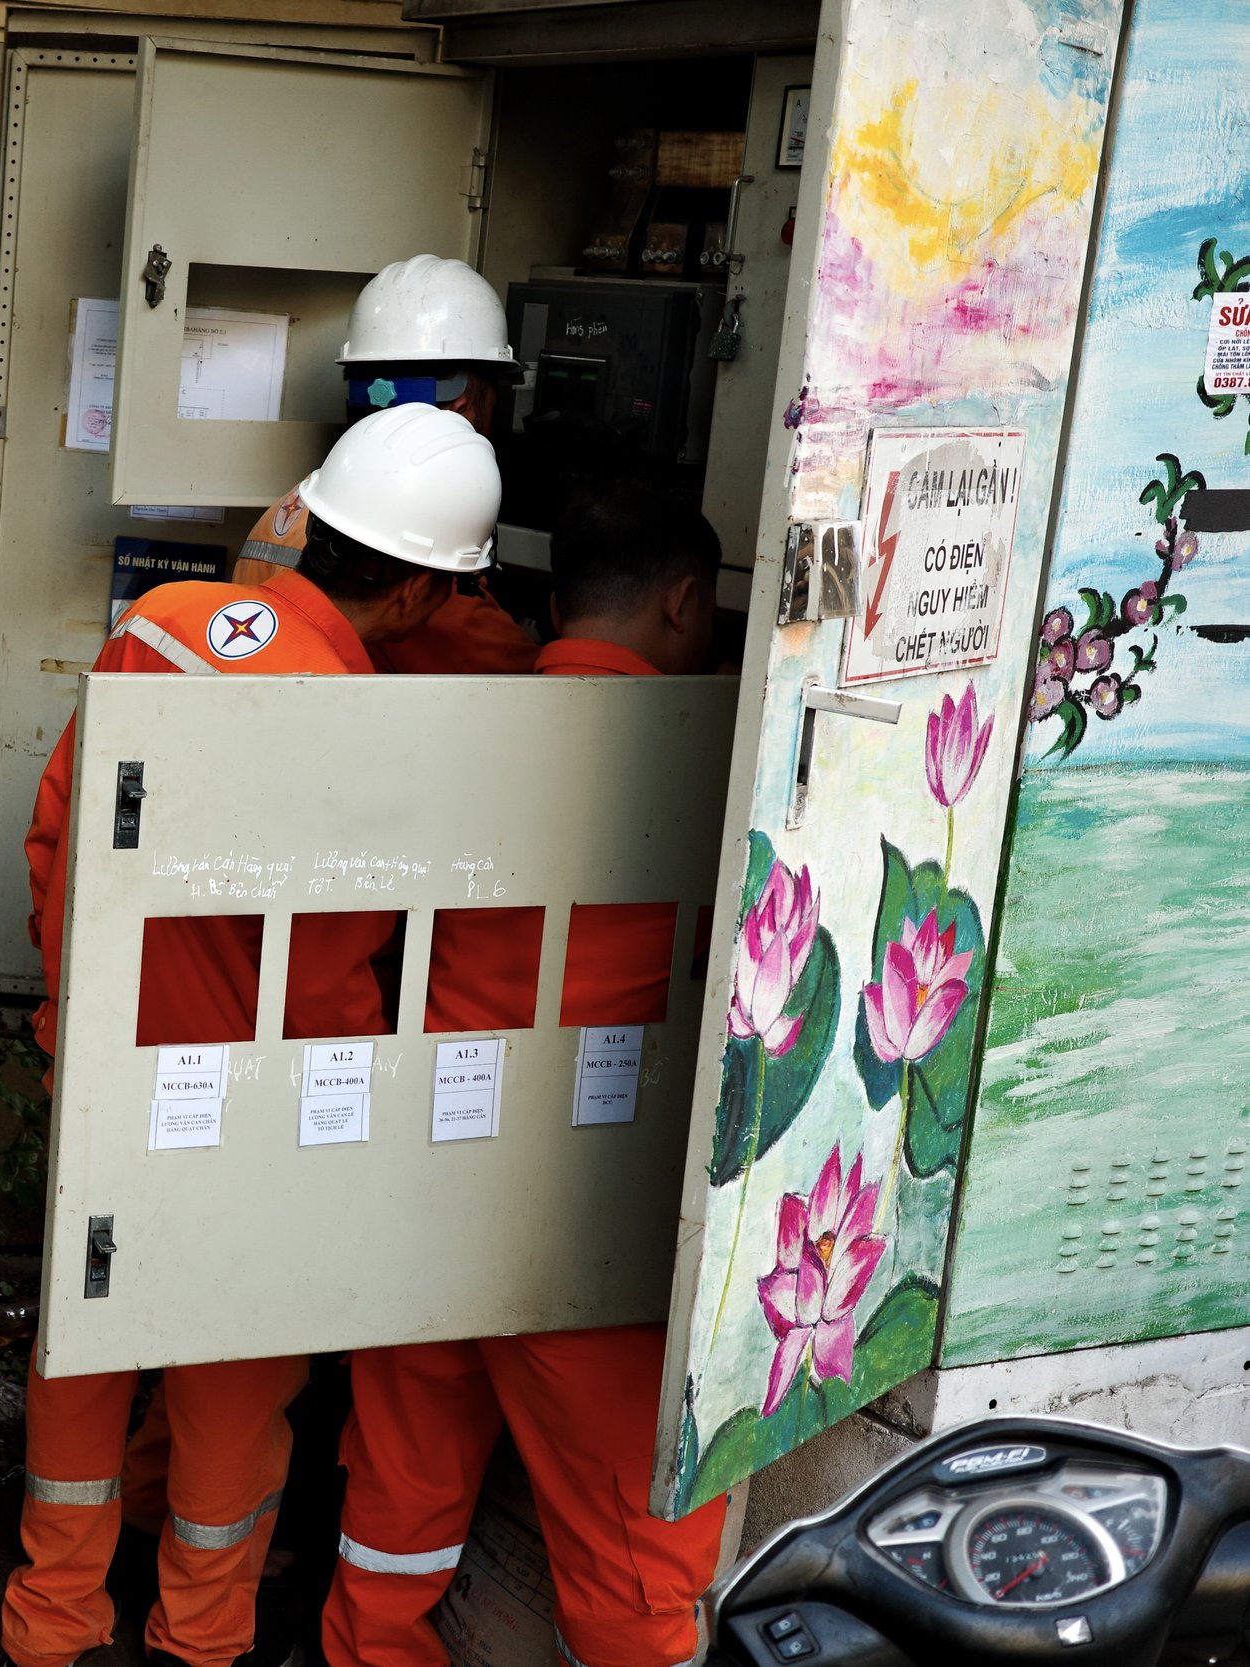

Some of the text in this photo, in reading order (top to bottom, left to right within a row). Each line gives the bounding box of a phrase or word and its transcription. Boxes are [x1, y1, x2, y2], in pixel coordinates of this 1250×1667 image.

[908, 461, 945, 511] CẤM
[947, 469, 973, 516] LẠI
[976, 459, 1009, 506] GẦN
[925, 539, 985, 575] CÓ ĐIỆN
[118, 553, 216, 574] SỔ NHẬT KÝ VẬN HÀNH
[907, 579, 989, 619] NGUY HIỂM
[896, 620, 989, 663] CHẾT NGƯỜI
[603, 1034, 626, 1044] A1.4
[178, 1055, 201, 1065] A1.1
[330, 1051, 354, 1062] A1.2
[455, 1048, 479, 1060] A1.3
[586, 1059, 637, 1069] MCCB 250A
[314, 1077, 365, 1087] MCCB-400A
[438, 1073, 492, 1085] MCCB 400A
[162, 1081, 214, 1091] MCCB-630A
